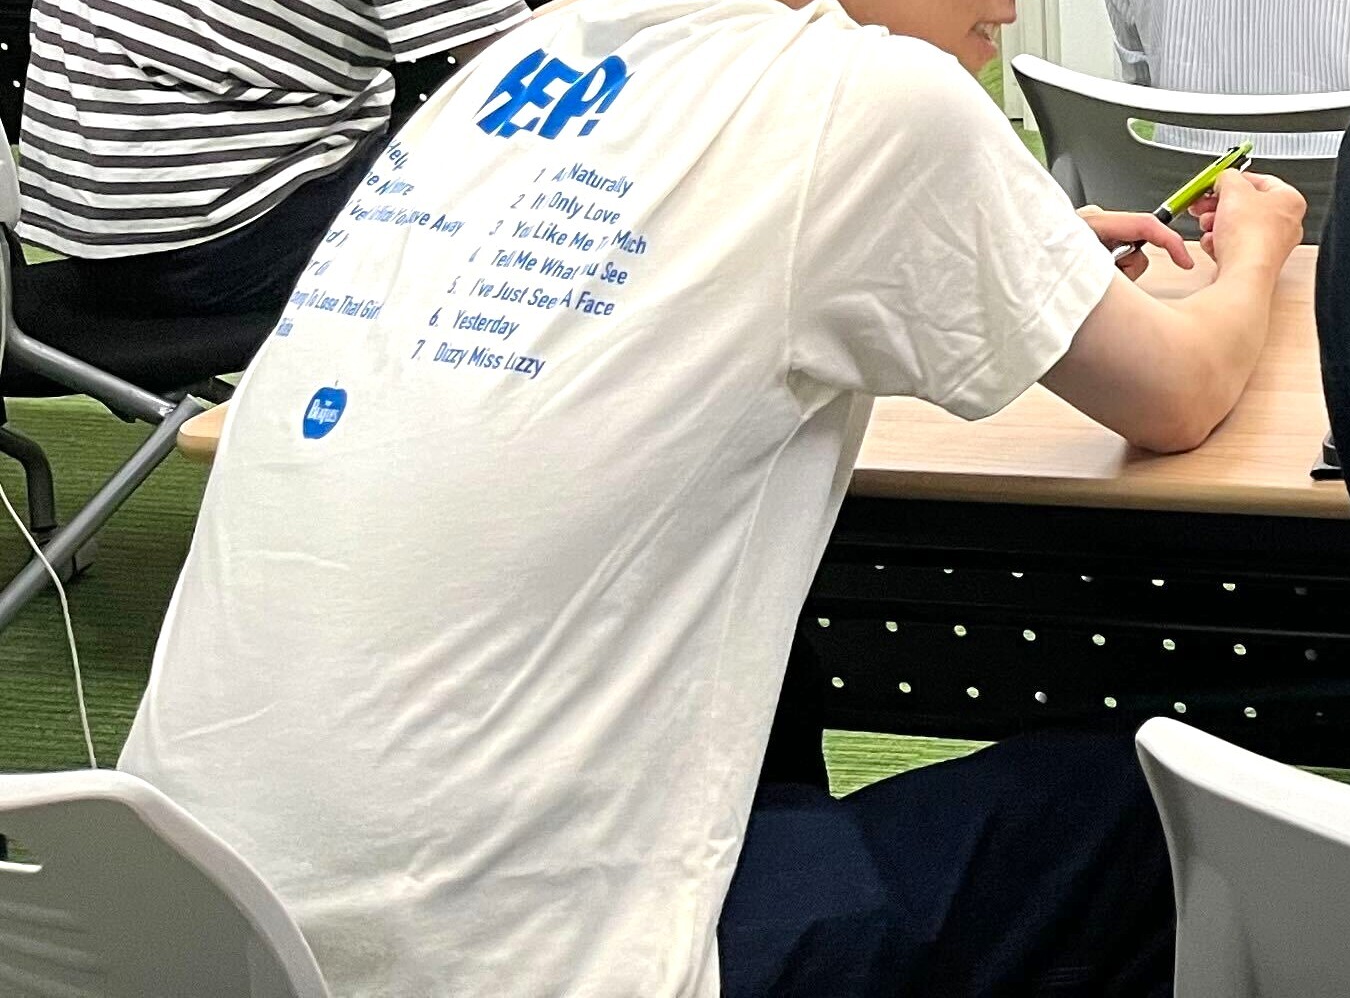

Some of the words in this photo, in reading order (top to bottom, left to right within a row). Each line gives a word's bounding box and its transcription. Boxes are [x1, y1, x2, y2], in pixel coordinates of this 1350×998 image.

[567, 162, 634, 199] Naturally
[548, 191, 584, 220] Only
[583, 202, 621, 225] Love
[532, 220, 568, 246] Like
[567, 231, 595, 252] Me
[511, 249, 538, 272] Me
[600, 261, 628, 285] See
[469, 278, 494, 298] I've
[491, 281, 530, 304] Just
[559, 288, 573, 308] A
[575, 291, 615, 316] Face
[453, 309, 520, 341] Yesterday
[433, 342, 469, 370] Dizzy
[467, 346, 504, 370] Miss
[503, 352, 547, 380] Lizzy
